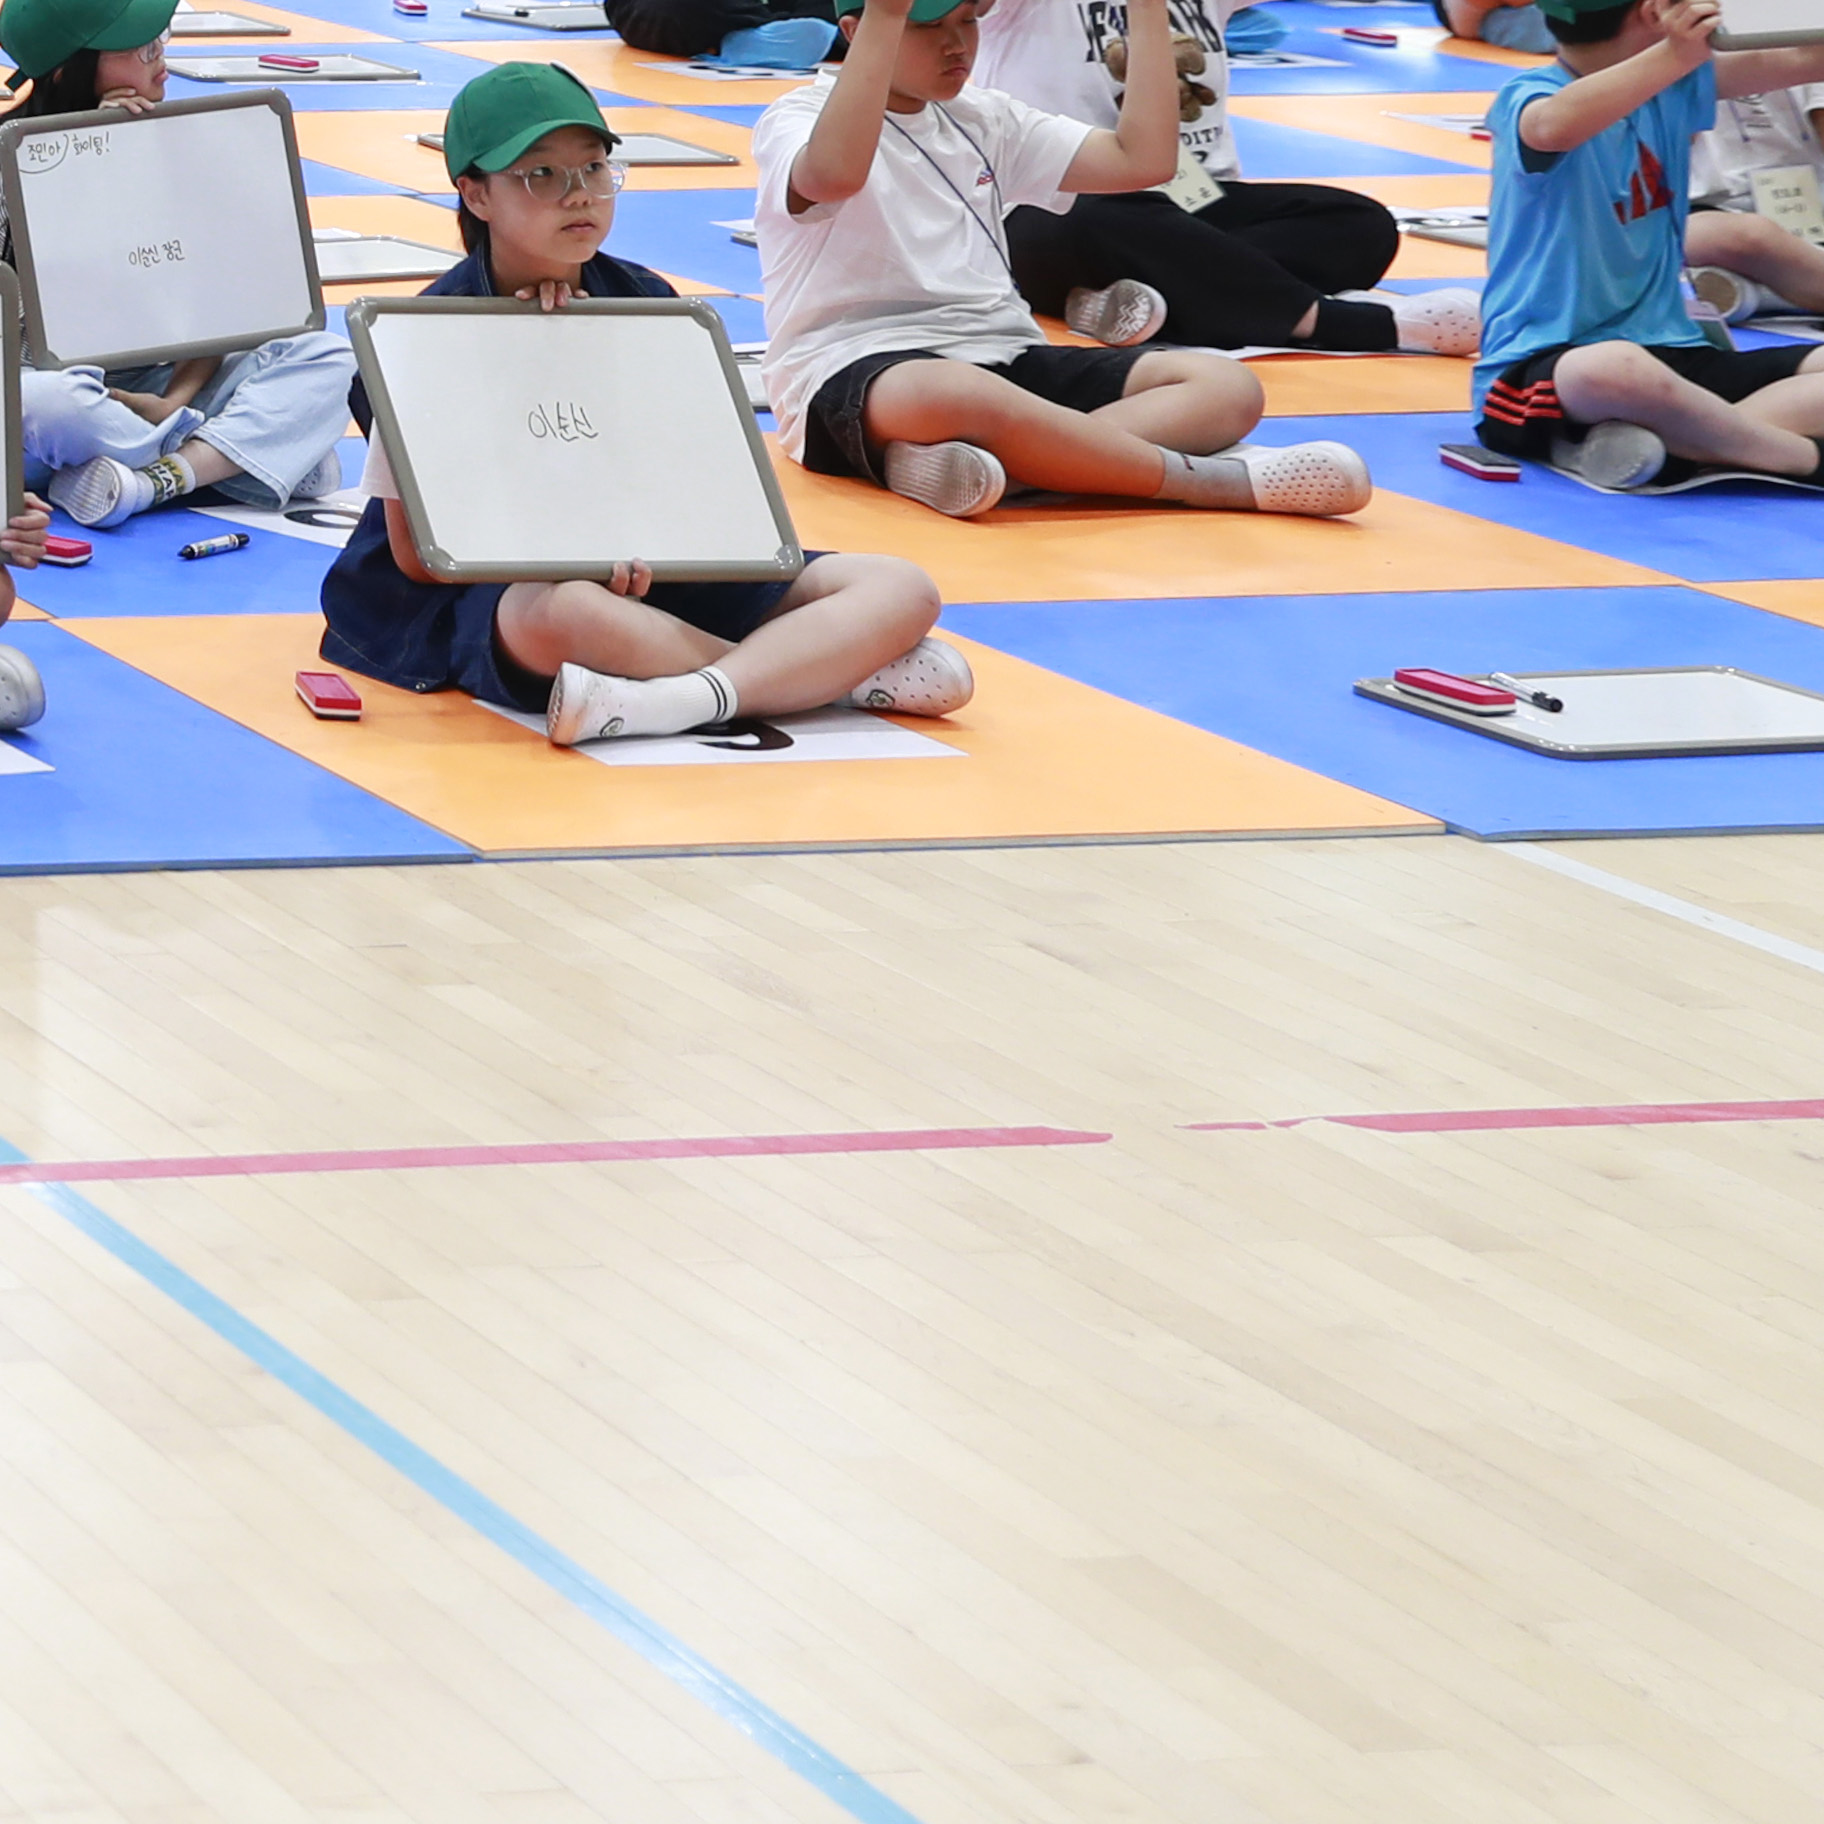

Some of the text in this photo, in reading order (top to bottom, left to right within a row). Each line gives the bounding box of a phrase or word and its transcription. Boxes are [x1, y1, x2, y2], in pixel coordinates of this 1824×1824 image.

[27, 131, 111, 164] 조민아 화이팅!
[128, 239, 186, 268] 이순신 장군
[527, 401, 600, 443] 이순신
